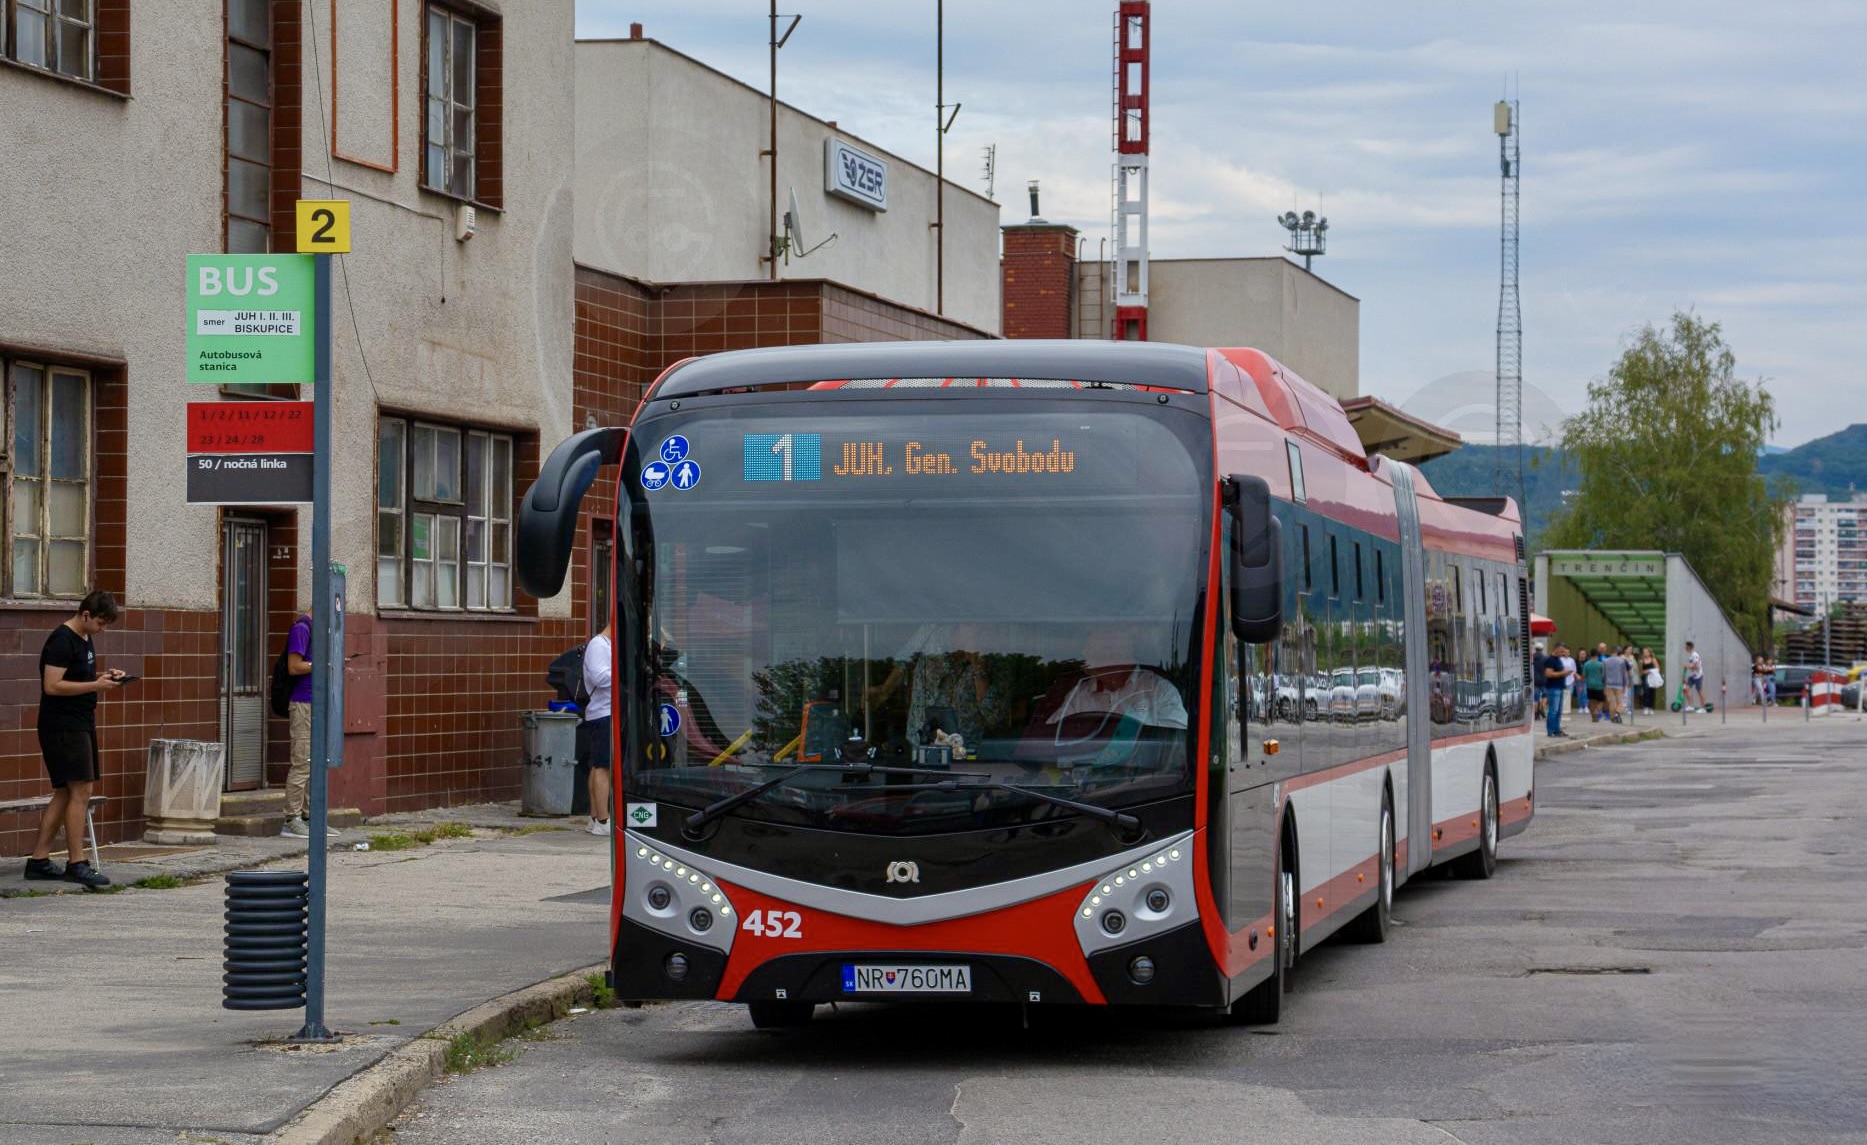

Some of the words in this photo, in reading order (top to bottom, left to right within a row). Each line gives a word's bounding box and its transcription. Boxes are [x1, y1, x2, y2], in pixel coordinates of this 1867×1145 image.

[311, 209, 336, 243] 2
[199, 266, 279, 297] BUS
[234, 312, 256, 321] JUH
[260, 312, 266, 321] I.
[269, 312, 279, 321] II.
[282, 312, 295, 321] III.
[234, 324, 294, 334] BISKUPICE
[199, 350, 262, 360] Autobusová
[199, 362, 237, 371] stanica
[201, 411, 207, 420] 1
[219, 411, 226, 420] 2
[238, 411, 250, 420] 11
[263, 411, 276, 420] 12
[288, 411, 302, 420] 22
[771, 433, 794, 482] 1
[833, 442, 893, 475] JUH.
[905, 442, 958, 475] Gen.
[199, 459, 212, 469] 50
[224, 458, 258, 469] nočná
[260, 458, 287, 469] linka
[633, 811, 649, 819] CNG
[742, 909, 803, 939] 452
[857, 968, 884, 989] NR
